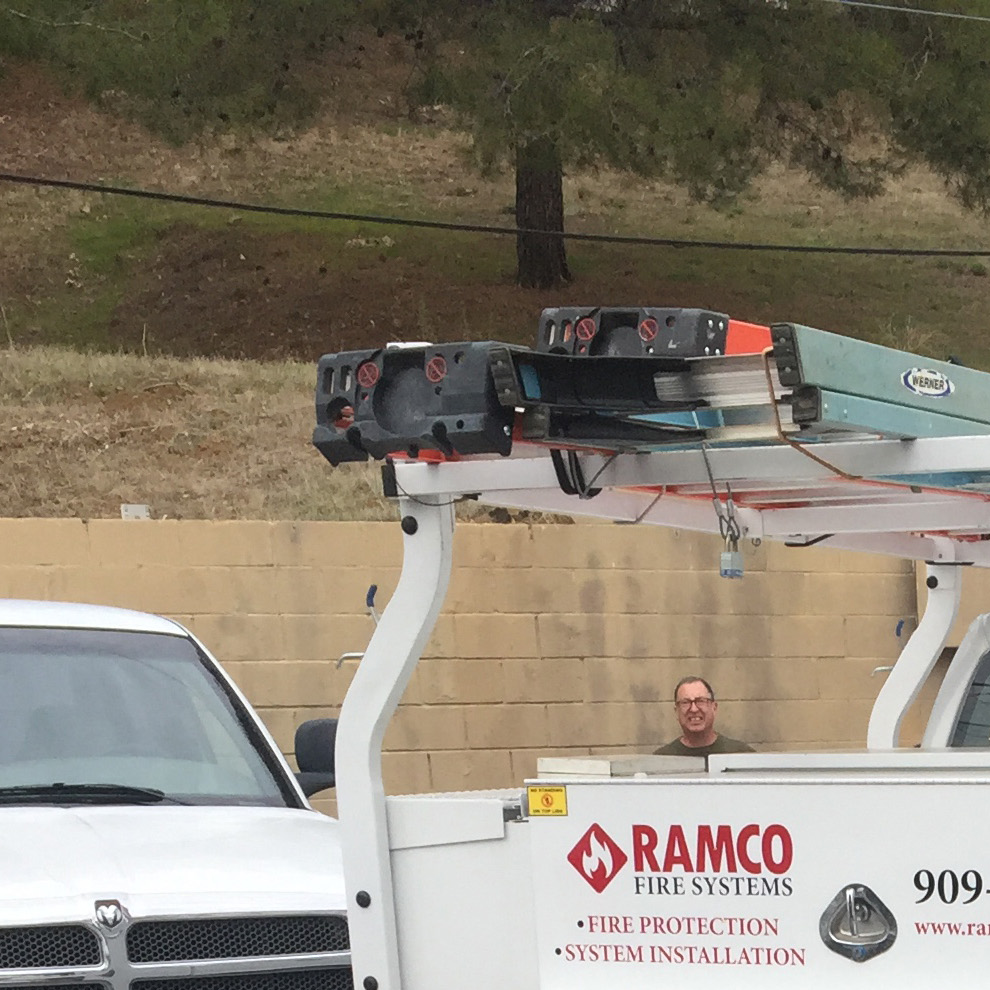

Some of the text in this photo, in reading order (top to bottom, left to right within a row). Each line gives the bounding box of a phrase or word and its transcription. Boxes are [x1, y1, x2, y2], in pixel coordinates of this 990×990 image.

[912, 375, 945, 391] WERNER
[631, 823, 794, 875] RAMCO
[633, 876, 794, 897] FIRE SYSTEMS
[639, 915, 780, 937] PROTECTION
[649, 945, 807, 967] INSTALLATION
